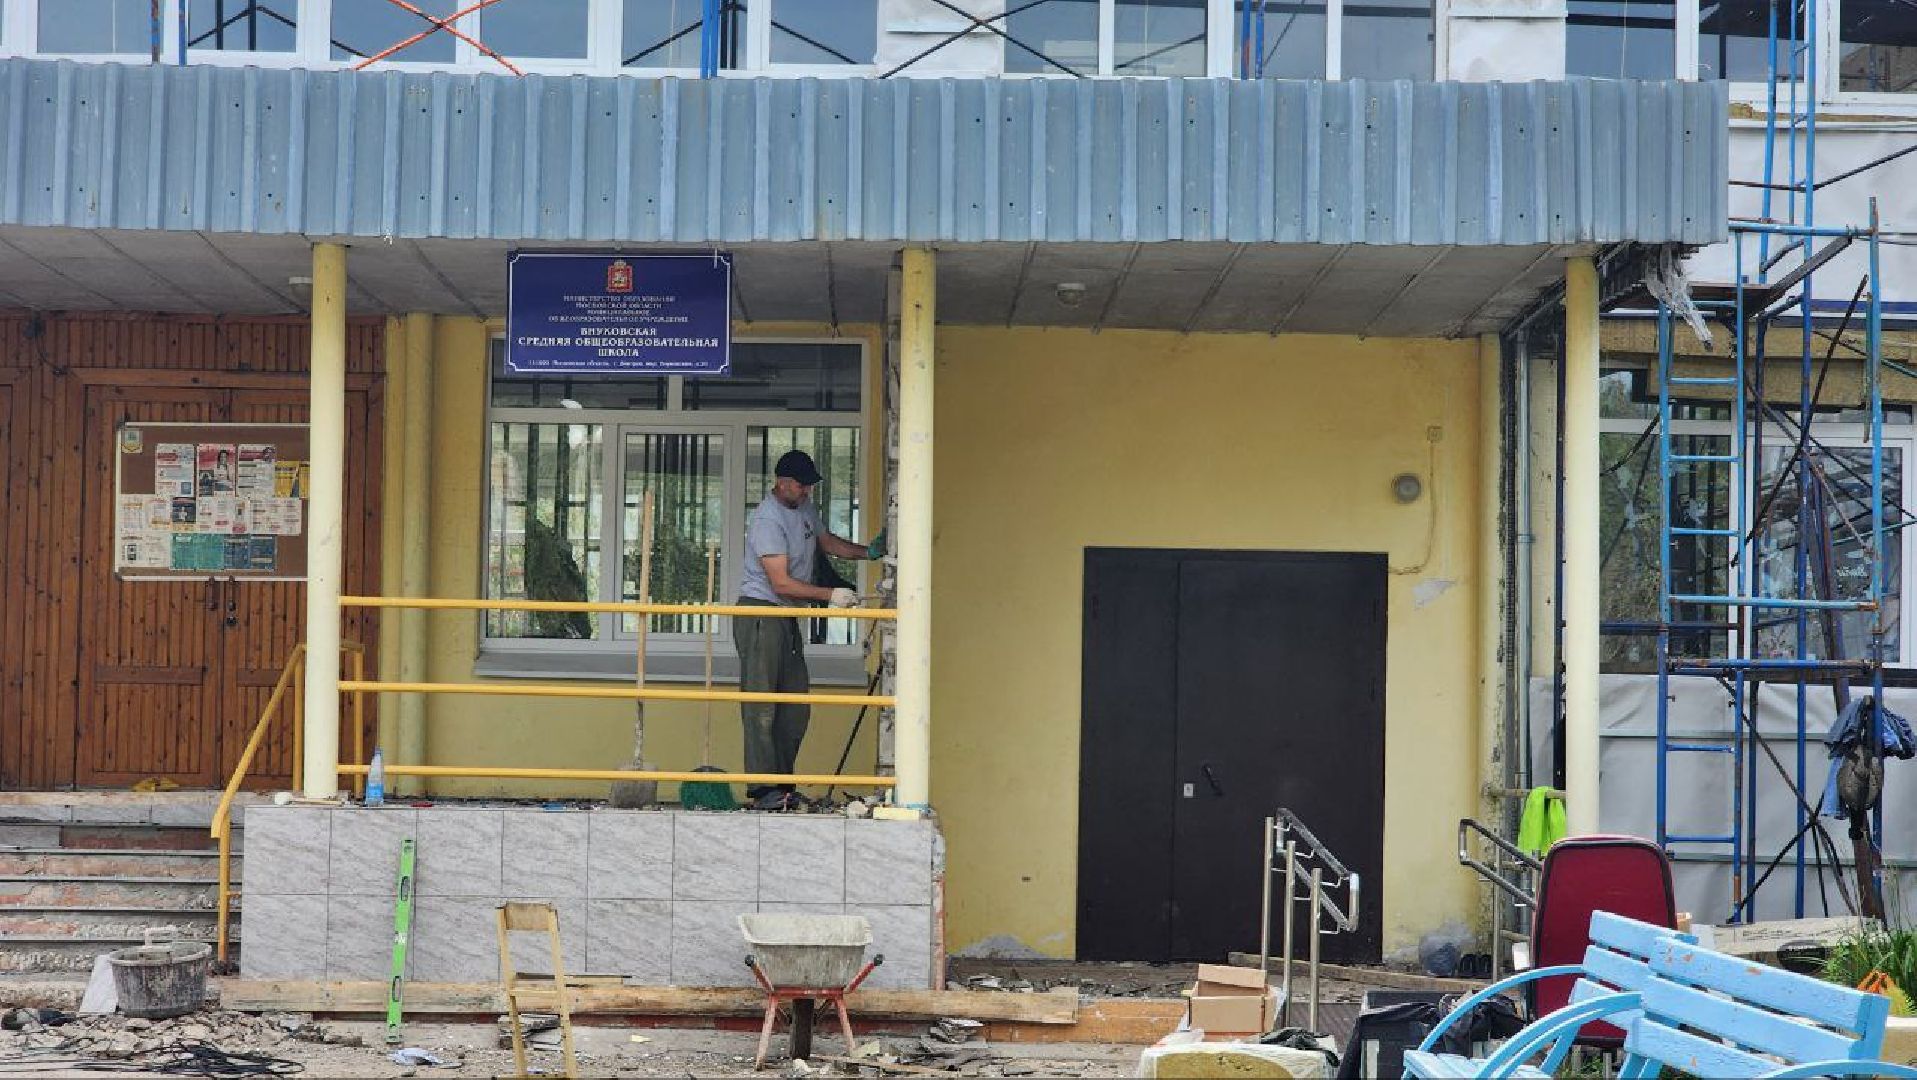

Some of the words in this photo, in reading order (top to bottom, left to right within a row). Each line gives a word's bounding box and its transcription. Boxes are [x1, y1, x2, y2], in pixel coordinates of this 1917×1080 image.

[580, 327, 657, 336] ВНУКОВСКАЯ
[518, 337, 571, 347] СРЕДНЯЯ
[575, 337, 719, 348] ОБЩЕОБРАЗОВАТЕЛЬНАЯ
[598, 348, 640, 357] ШКОЛА
